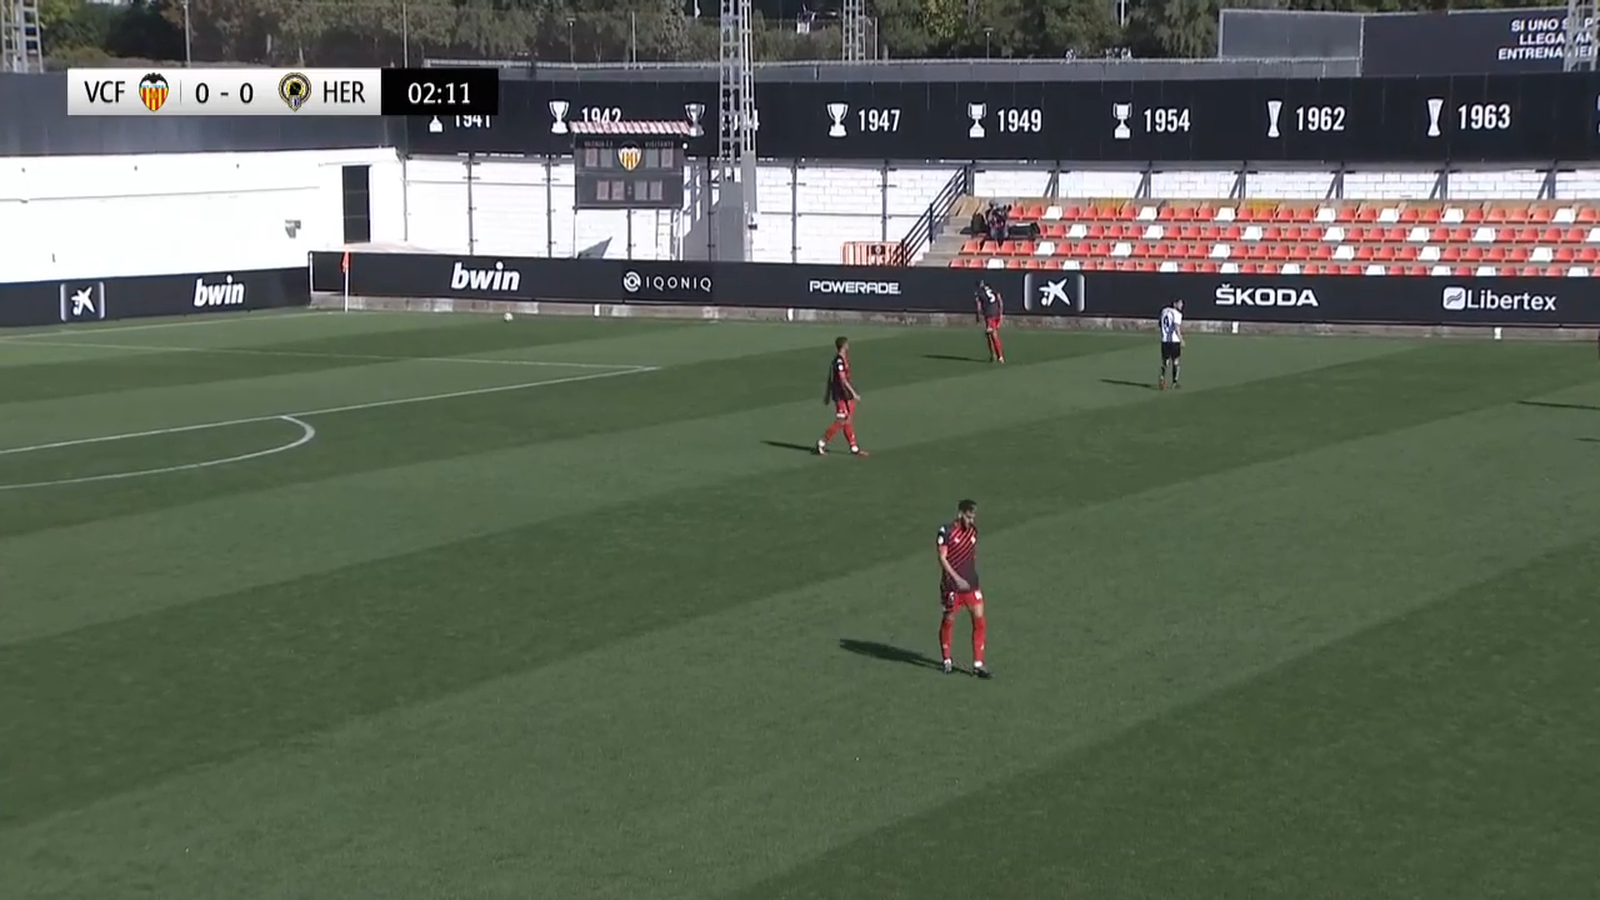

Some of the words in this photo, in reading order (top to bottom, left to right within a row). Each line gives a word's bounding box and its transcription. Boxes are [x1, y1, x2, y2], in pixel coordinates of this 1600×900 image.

[1511, 19, 1525, 31] SI
[1528, 18, 1558, 31] UNO
[858, 109, 901, 132] 1947
[997, 109, 1042, 132] 1949
[1144, 108, 1191, 132] 1954
[1296, 107, 1346, 131] 1962
[1458, 104, 1511, 129] 1963
[451, 263, 520, 291] bwin
[647, 276, 712, 293] IQONIQ
[810, 281, 899, 295] POWERADE
[194, 275, 246, 306] bwin
[986, 289, 996, 303] 5
[1215, 284, 1319, 307] ŠKODA
[1466, 289, 1557, 311] Libertex
